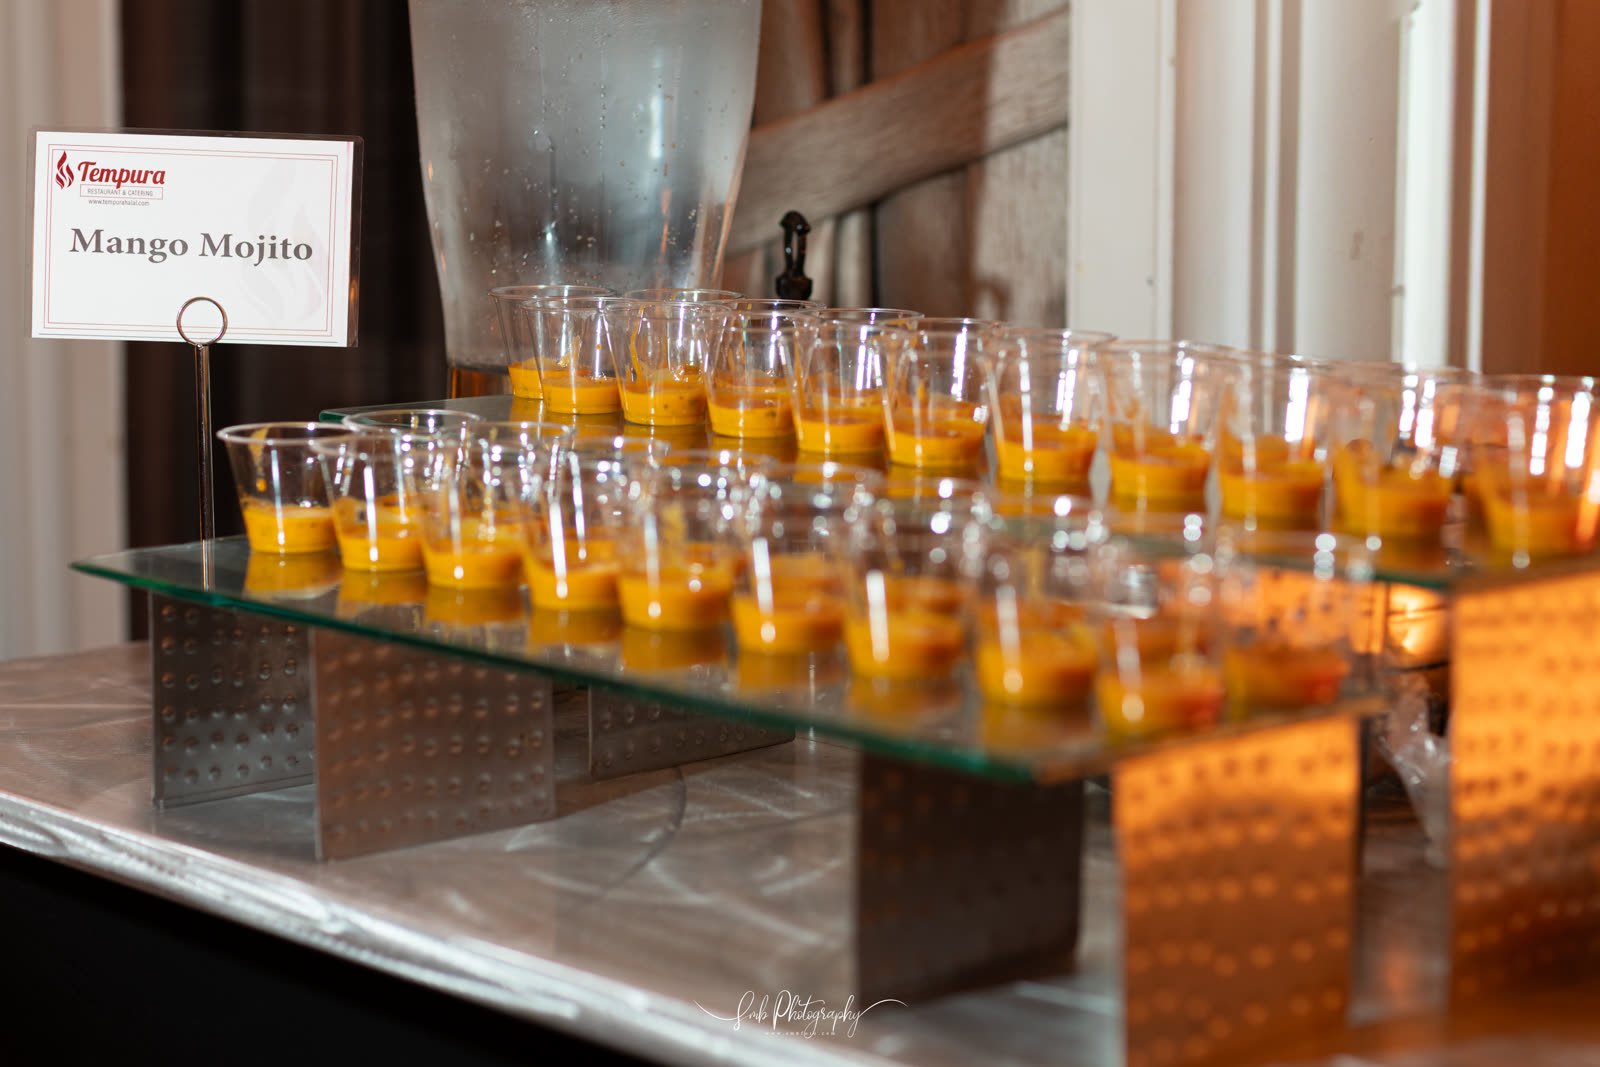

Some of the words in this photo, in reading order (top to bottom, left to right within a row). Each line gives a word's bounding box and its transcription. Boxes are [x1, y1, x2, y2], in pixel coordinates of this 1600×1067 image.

[78, 160, 166, 190] Tempura
[87, 187, 121, 196] RESTAURANT
[127, 189, 154, 197] CATERING
[88, 199, 150, 207] www.tempurahalal.com
[69, 228, 189, 264] Mango
[198, 232, 313, 267] Mojito
